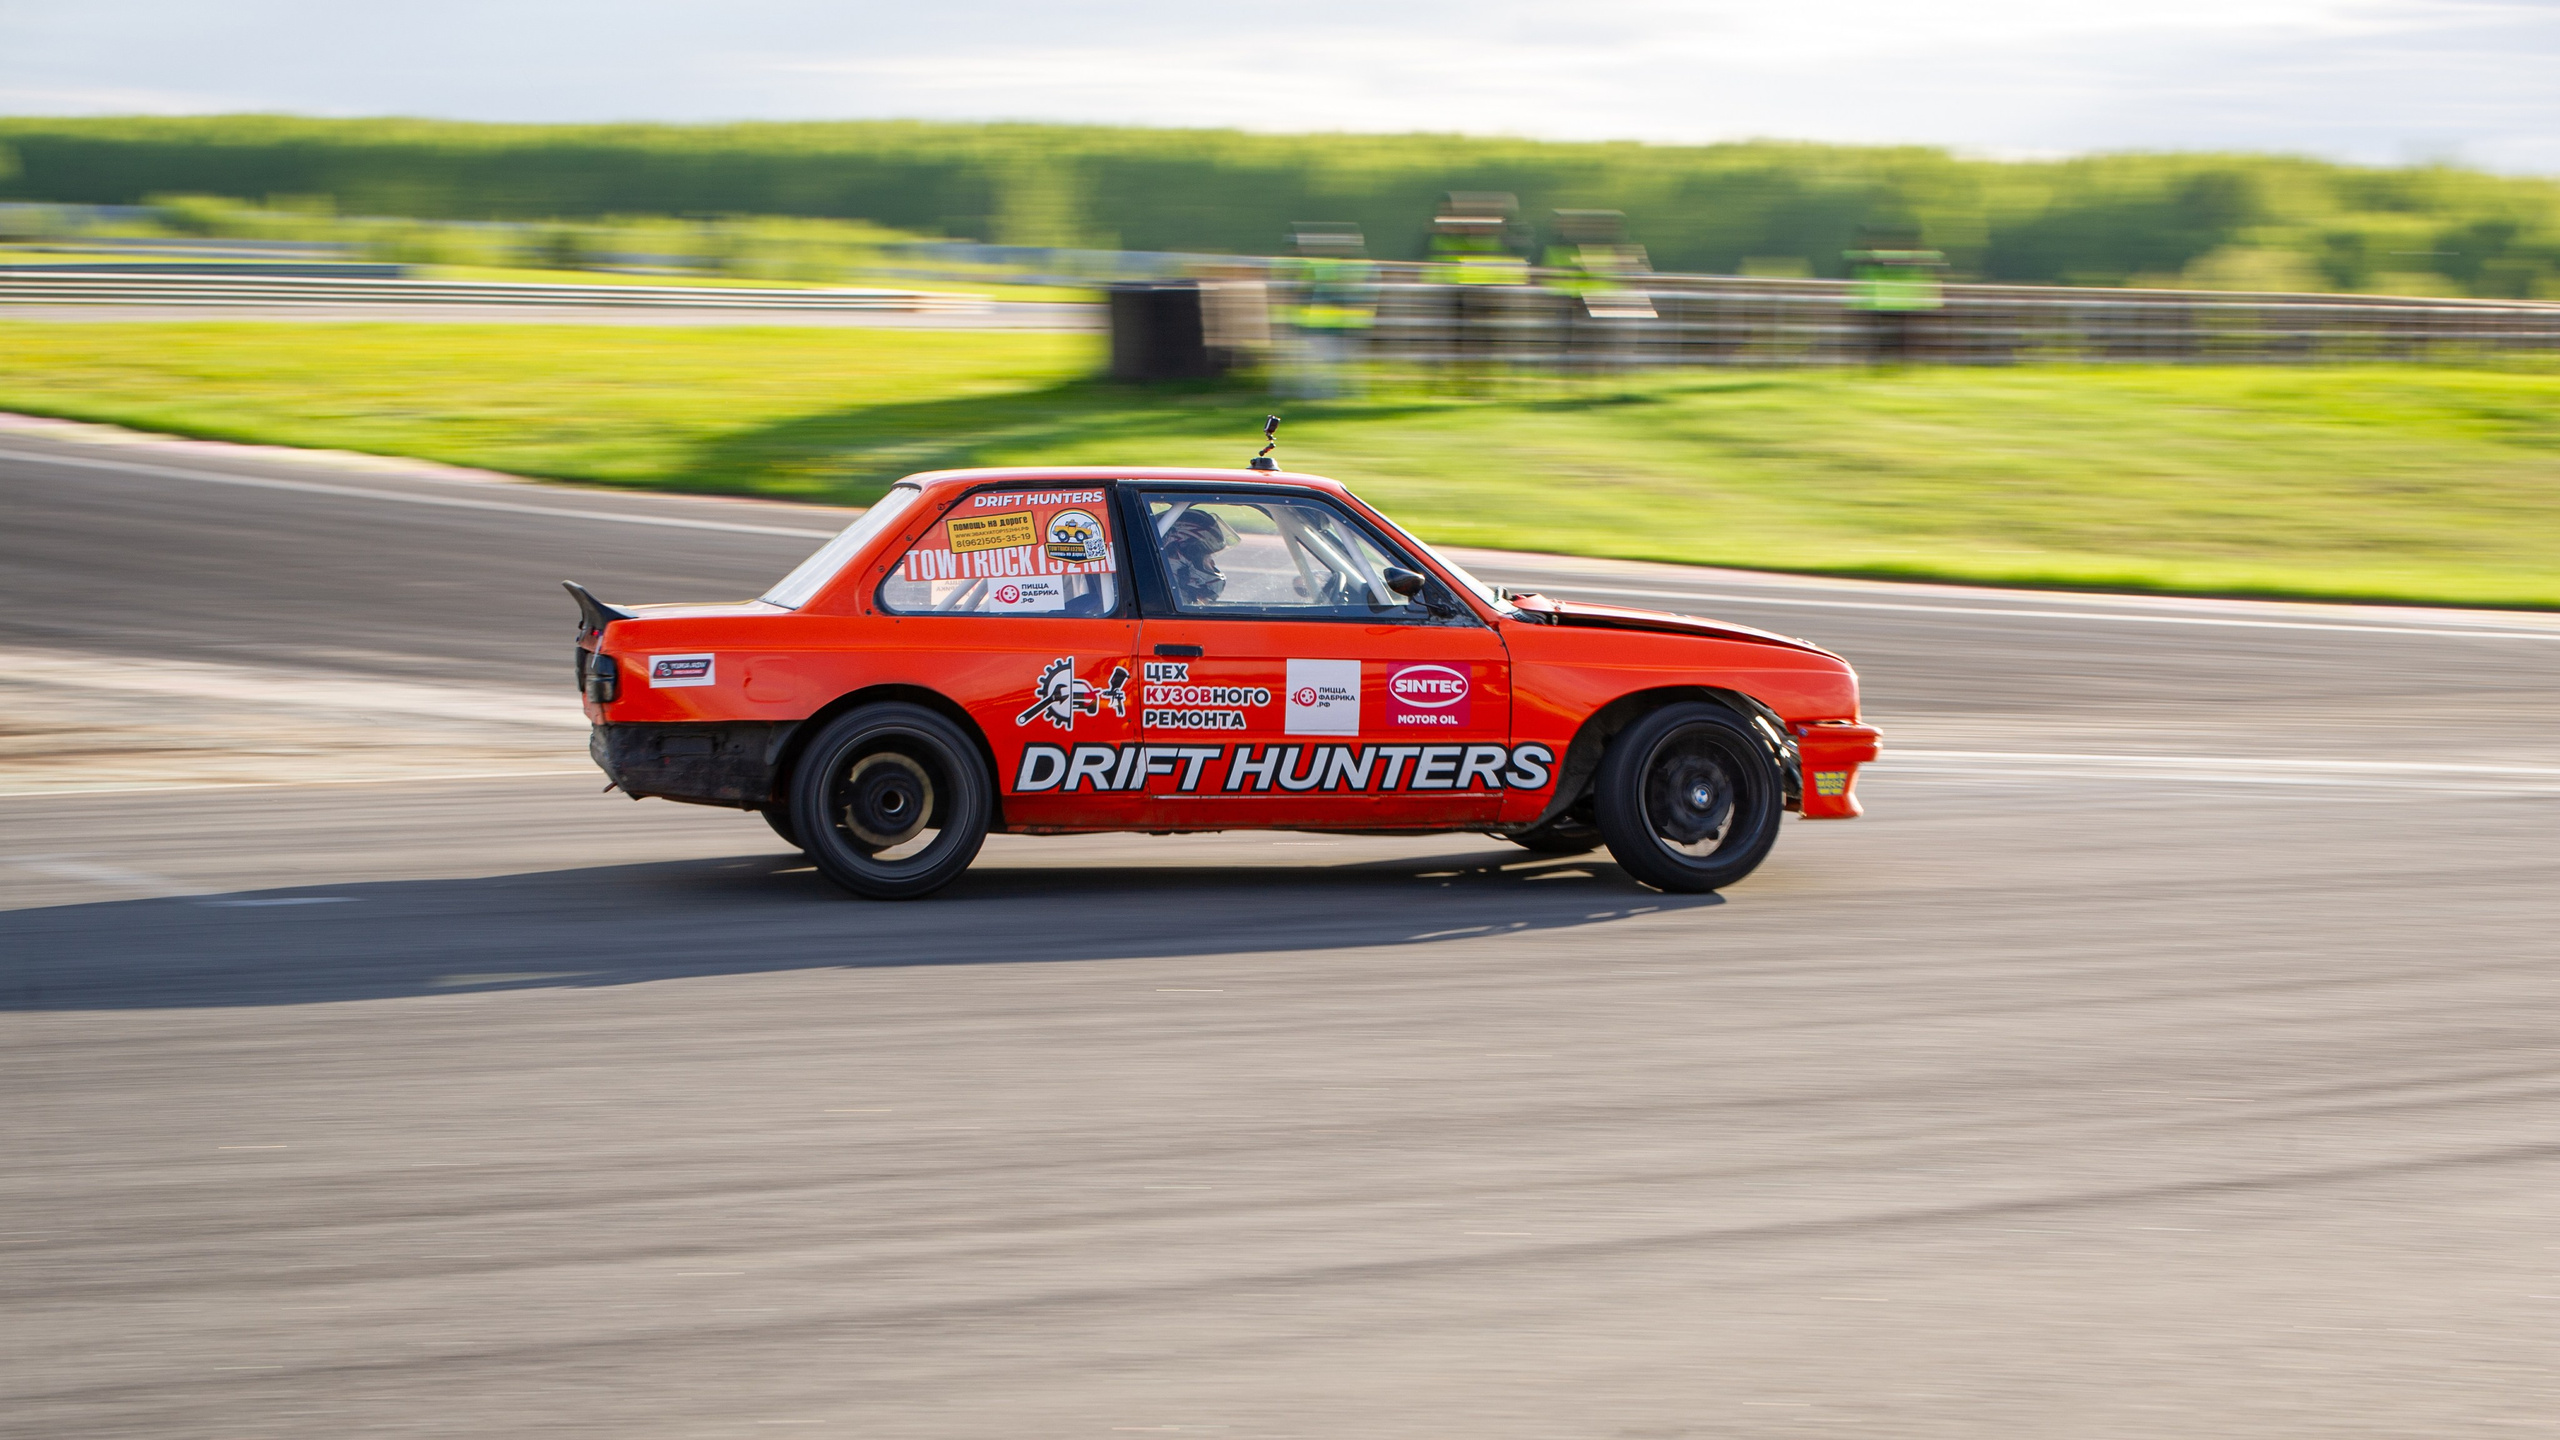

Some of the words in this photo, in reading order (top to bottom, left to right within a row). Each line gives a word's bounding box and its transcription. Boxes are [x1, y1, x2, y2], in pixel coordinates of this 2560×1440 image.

[974, 494, 1024, 507] DRIFT
[1026, 491, 1104, 505] HUNTERS
[953, 521, 985, 531] помощь
[988, 519, 997, 527] на
[1000, 516, 1028, 526] дороге
[956, 532, 1031, 548] 8(962)505-35-19
[1145, 664, 1187, 682] ЦЕХ
[1319, 686, 1346, 694] ПИЦЦА
[1395, 679, 1463, 694] SINTEC
[1145, 687, 1270, 705] КУЗОВНОГО
[1144, 710, 1245, 727] РЕМОНТА
[1398, 715, 1437, 724] MOTOR
[1441, 715, 1458, 725] OIL
[1015, 746, 1221, 791] DRIFT
[1225, 745, 1553, 790] HUNTERS
